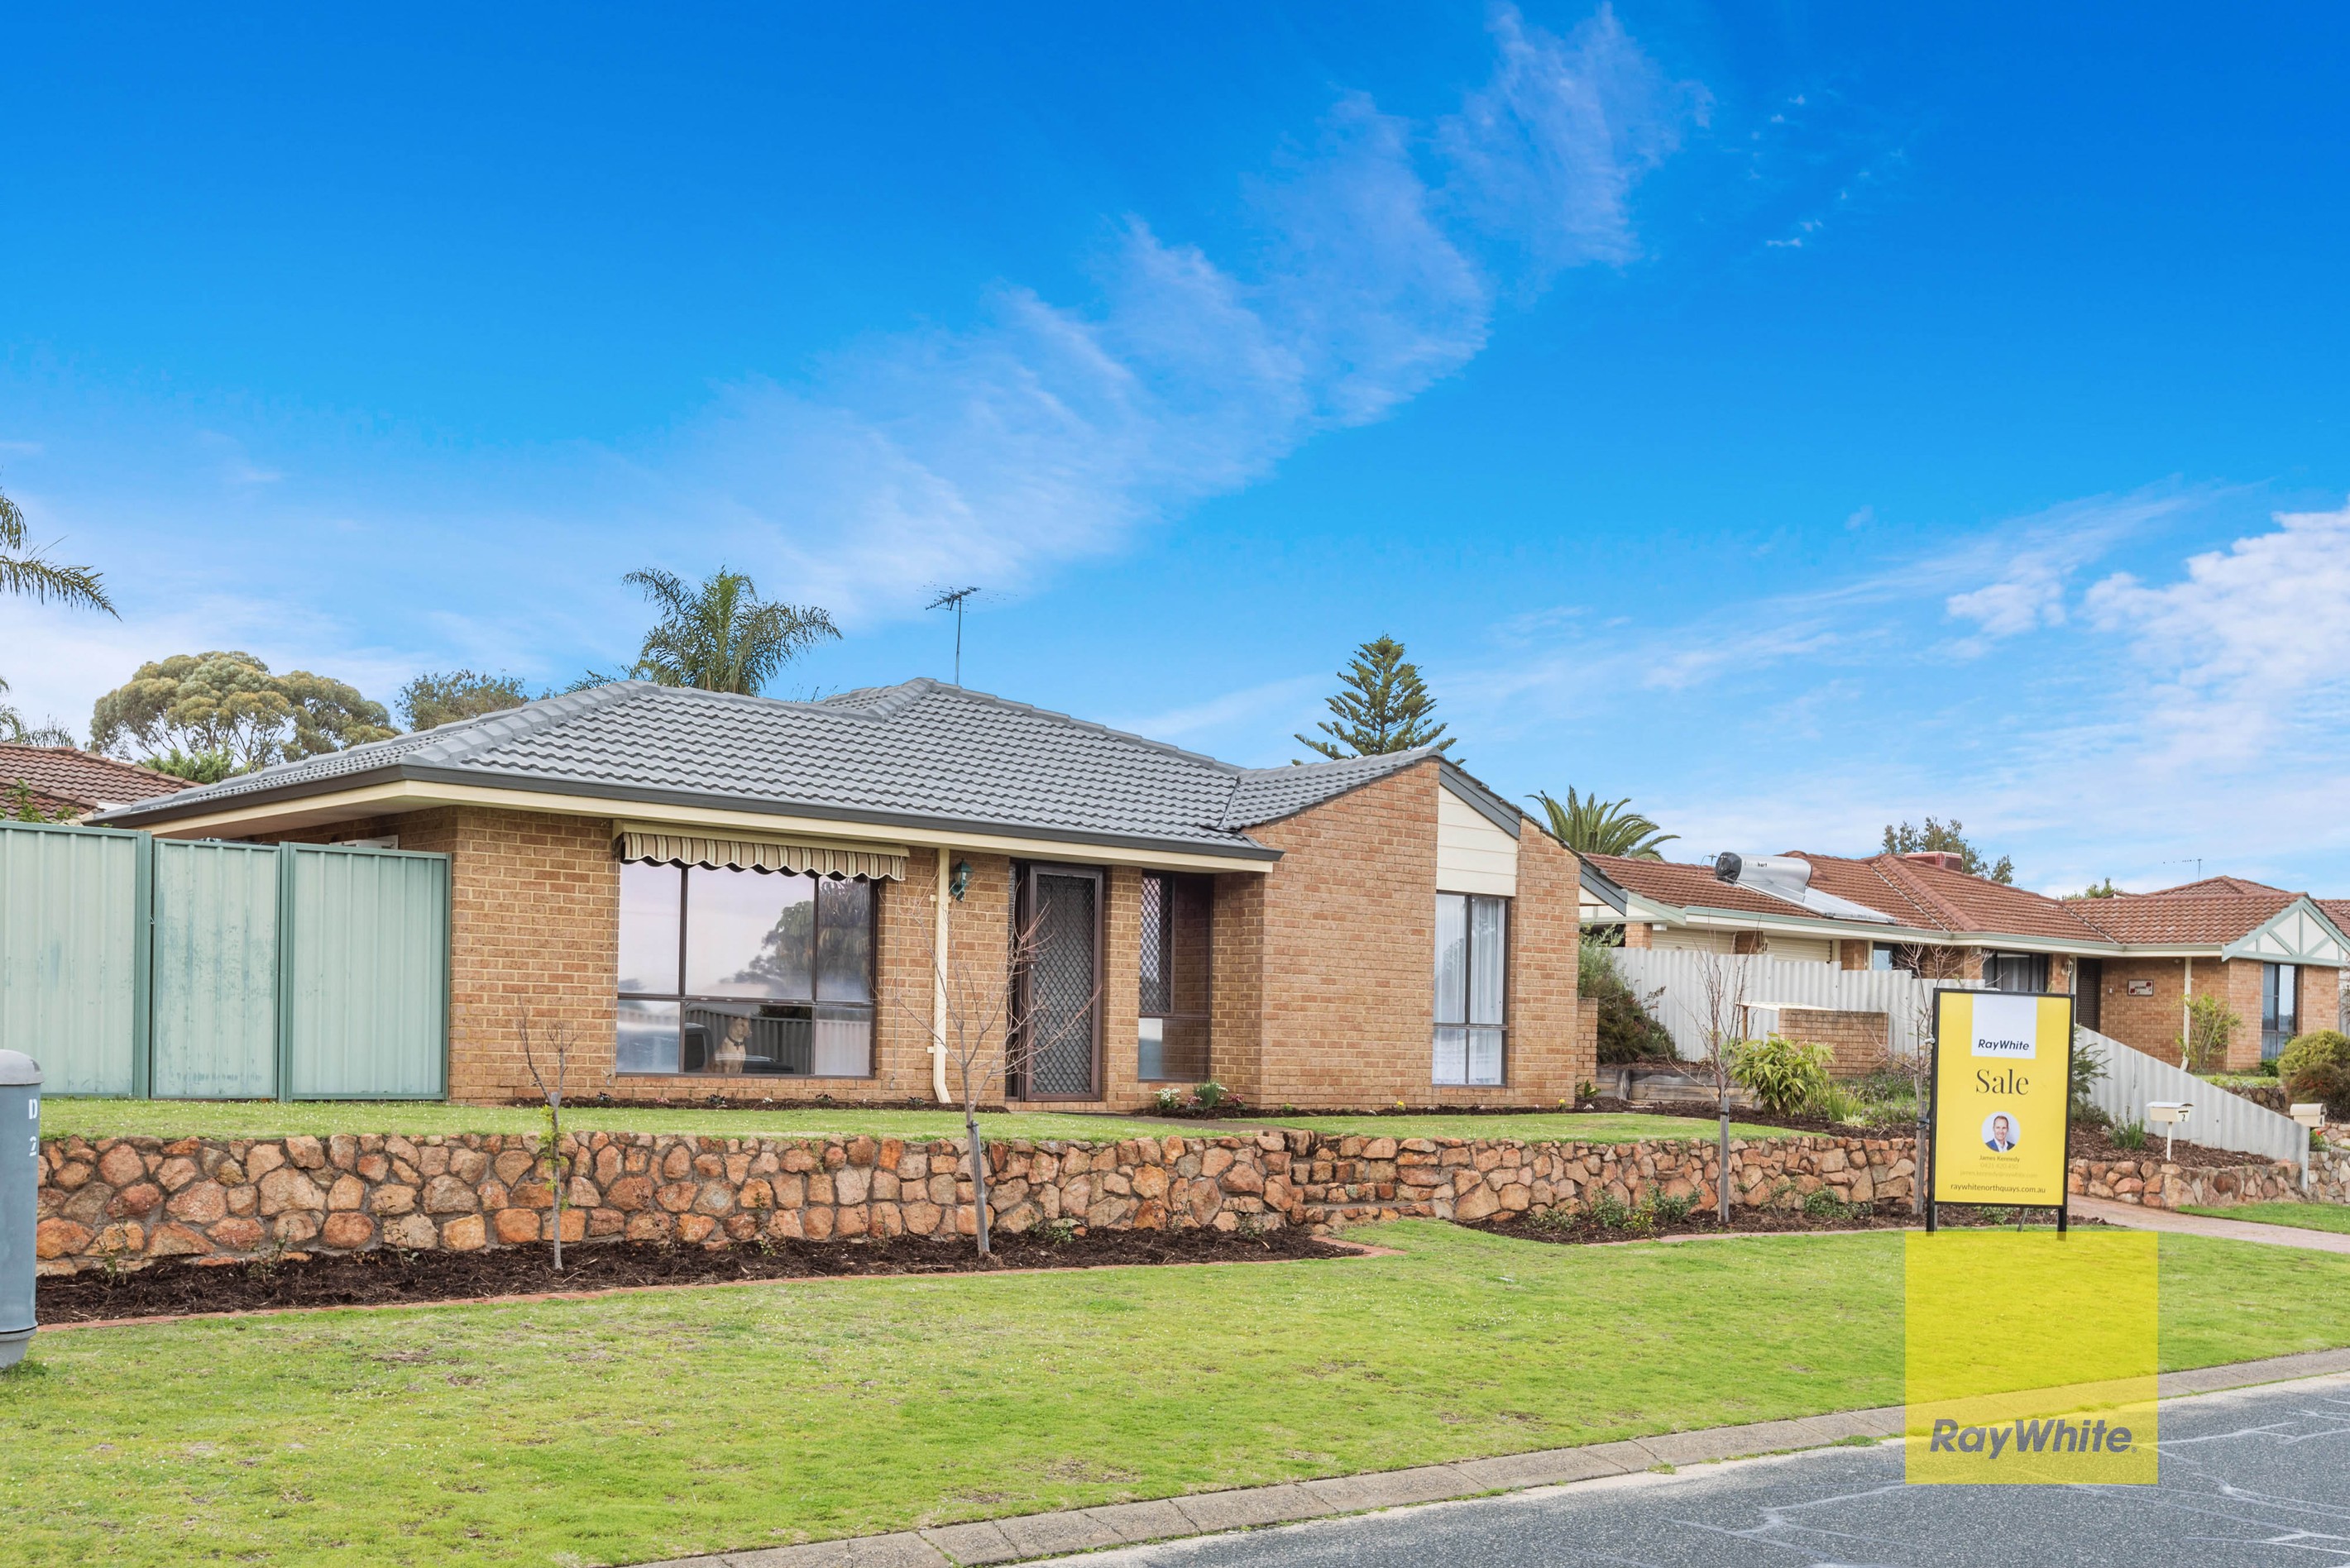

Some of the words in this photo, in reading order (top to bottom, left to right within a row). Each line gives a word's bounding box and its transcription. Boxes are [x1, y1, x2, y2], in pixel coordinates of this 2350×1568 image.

[1978, 1039, 2030, 1050] RayWhite
[1976, 1068, 2029, 1096] Sale
[29, 1098, 38, 1120] D
[2181, 1113, 2186, 1122] 2
[29, 1135, 37, 1157] 2
[1950, 1183, 2046, 1193] raywhitenorthquays.com.au
